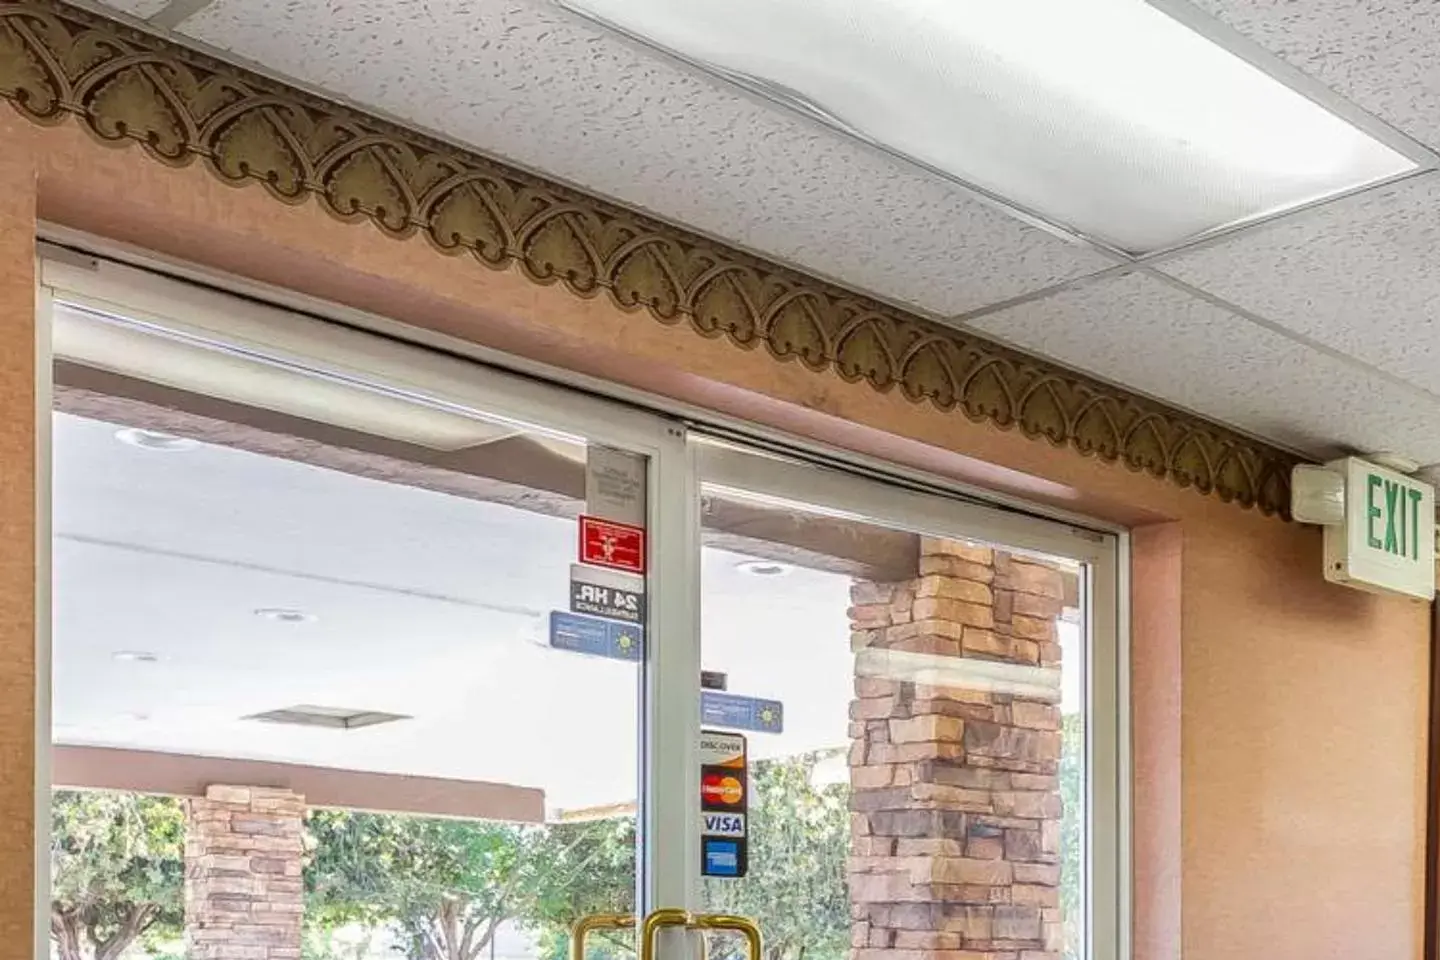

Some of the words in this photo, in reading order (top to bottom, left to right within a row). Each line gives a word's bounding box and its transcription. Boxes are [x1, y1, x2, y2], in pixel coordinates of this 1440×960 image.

[1367, 474, 1422, 561] EXIT
[700, 740, 741, 751] DISCOVER
[705, 815, 743, 832] VISA
